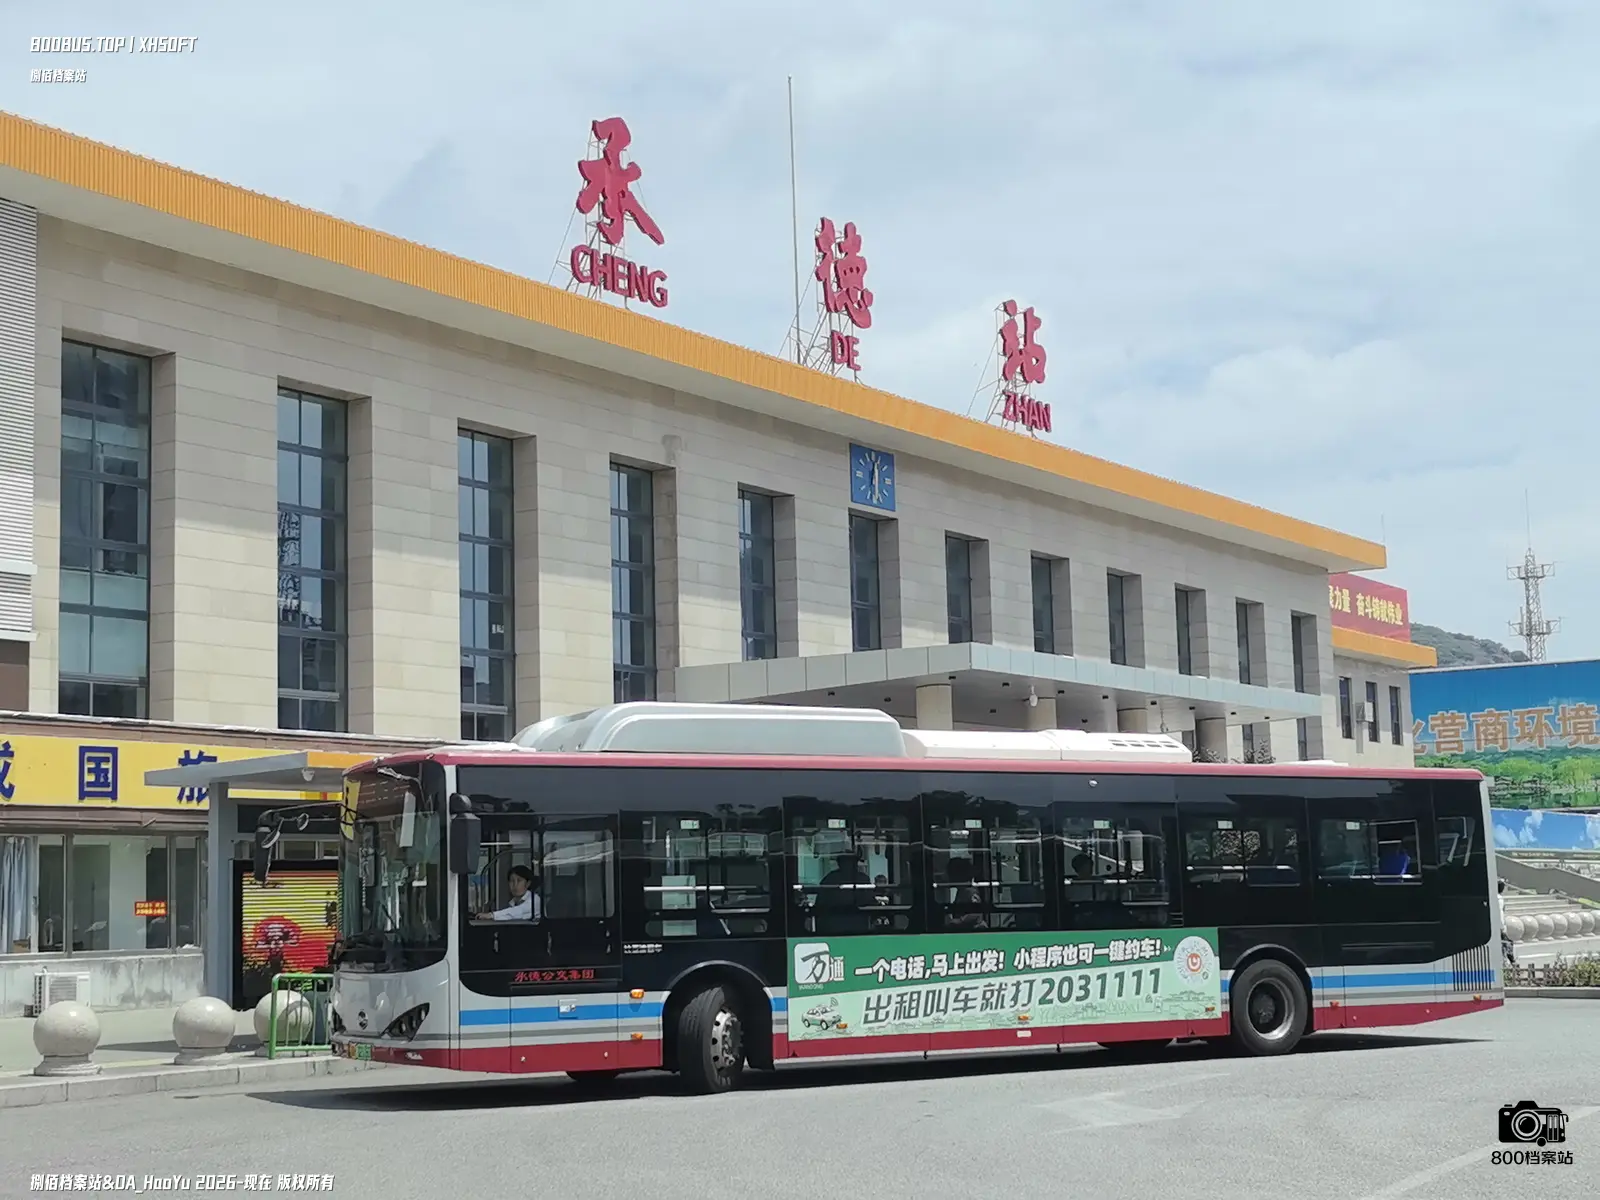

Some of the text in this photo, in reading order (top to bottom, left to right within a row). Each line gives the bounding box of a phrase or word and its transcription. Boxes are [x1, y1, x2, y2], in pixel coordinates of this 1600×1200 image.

[571, 244, 1051, 433] CHENG DE ZHAN
[576, 117, 1047, 384] 承 德 站
[861, 967, 1161, 1025] 出租叫车就打2031111
